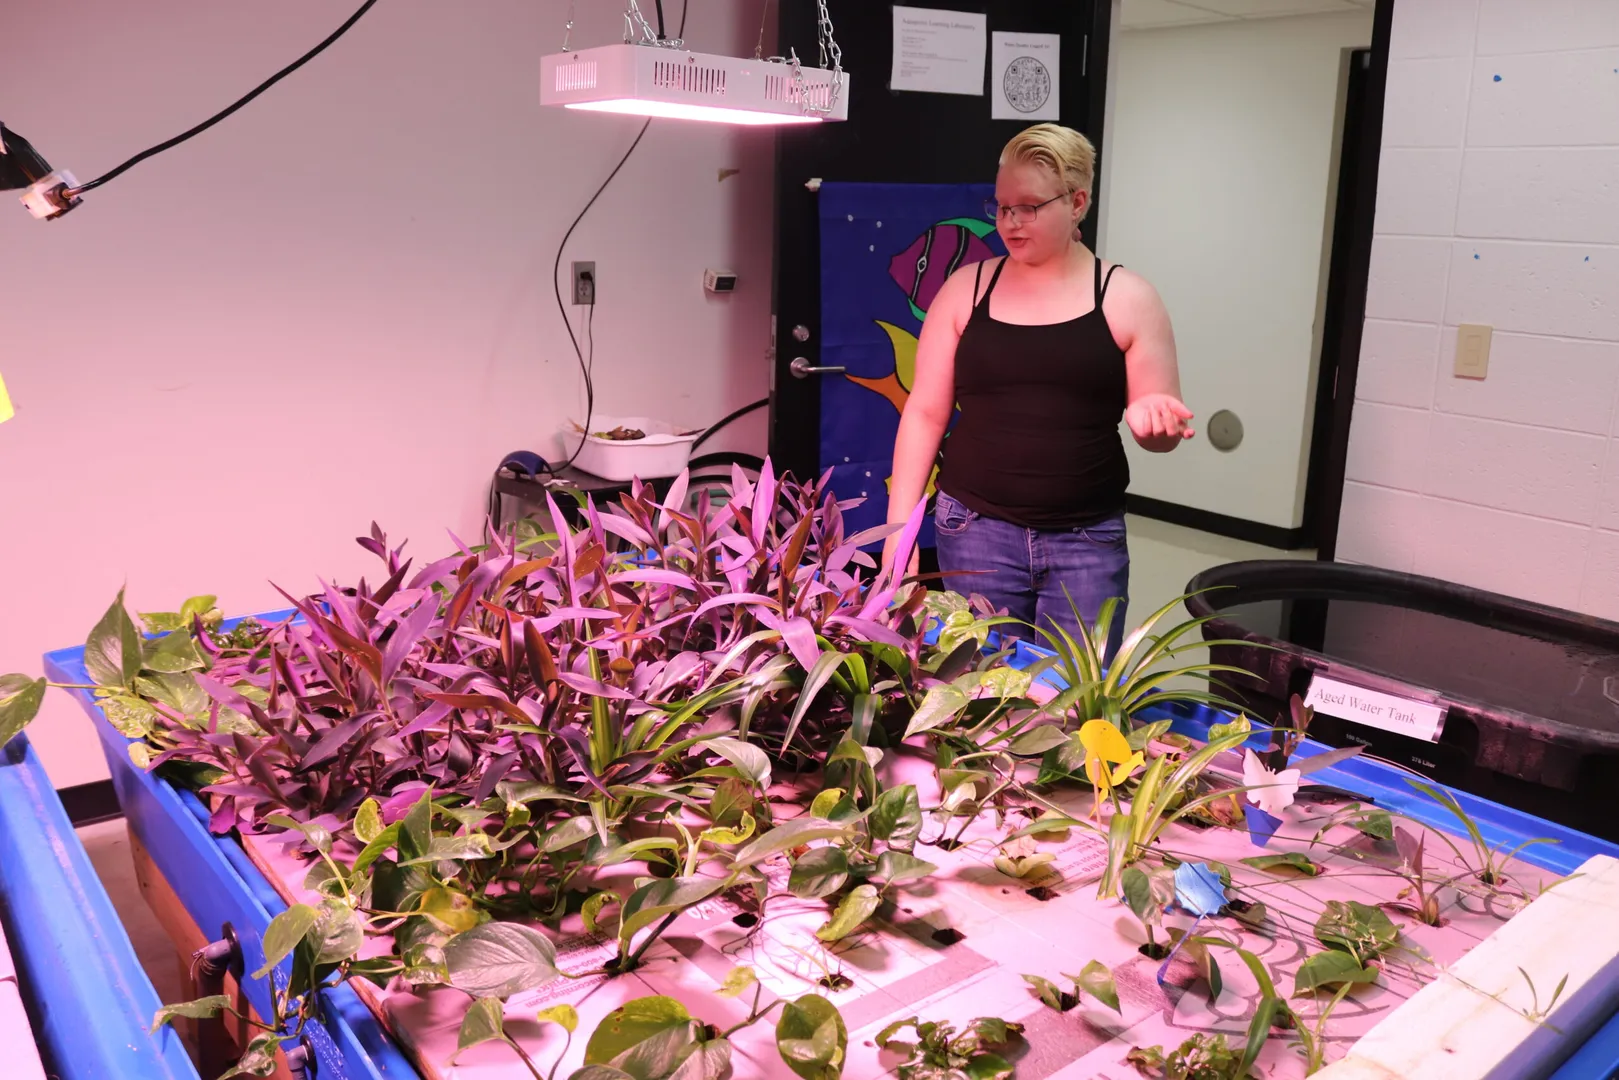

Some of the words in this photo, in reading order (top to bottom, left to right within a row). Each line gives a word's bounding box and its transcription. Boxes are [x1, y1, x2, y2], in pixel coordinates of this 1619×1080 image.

[1314, 688, 1346, 706] Aged
[1348, 696, 1384, 716] Water
[1388, 706, 1417, 725] Tank
